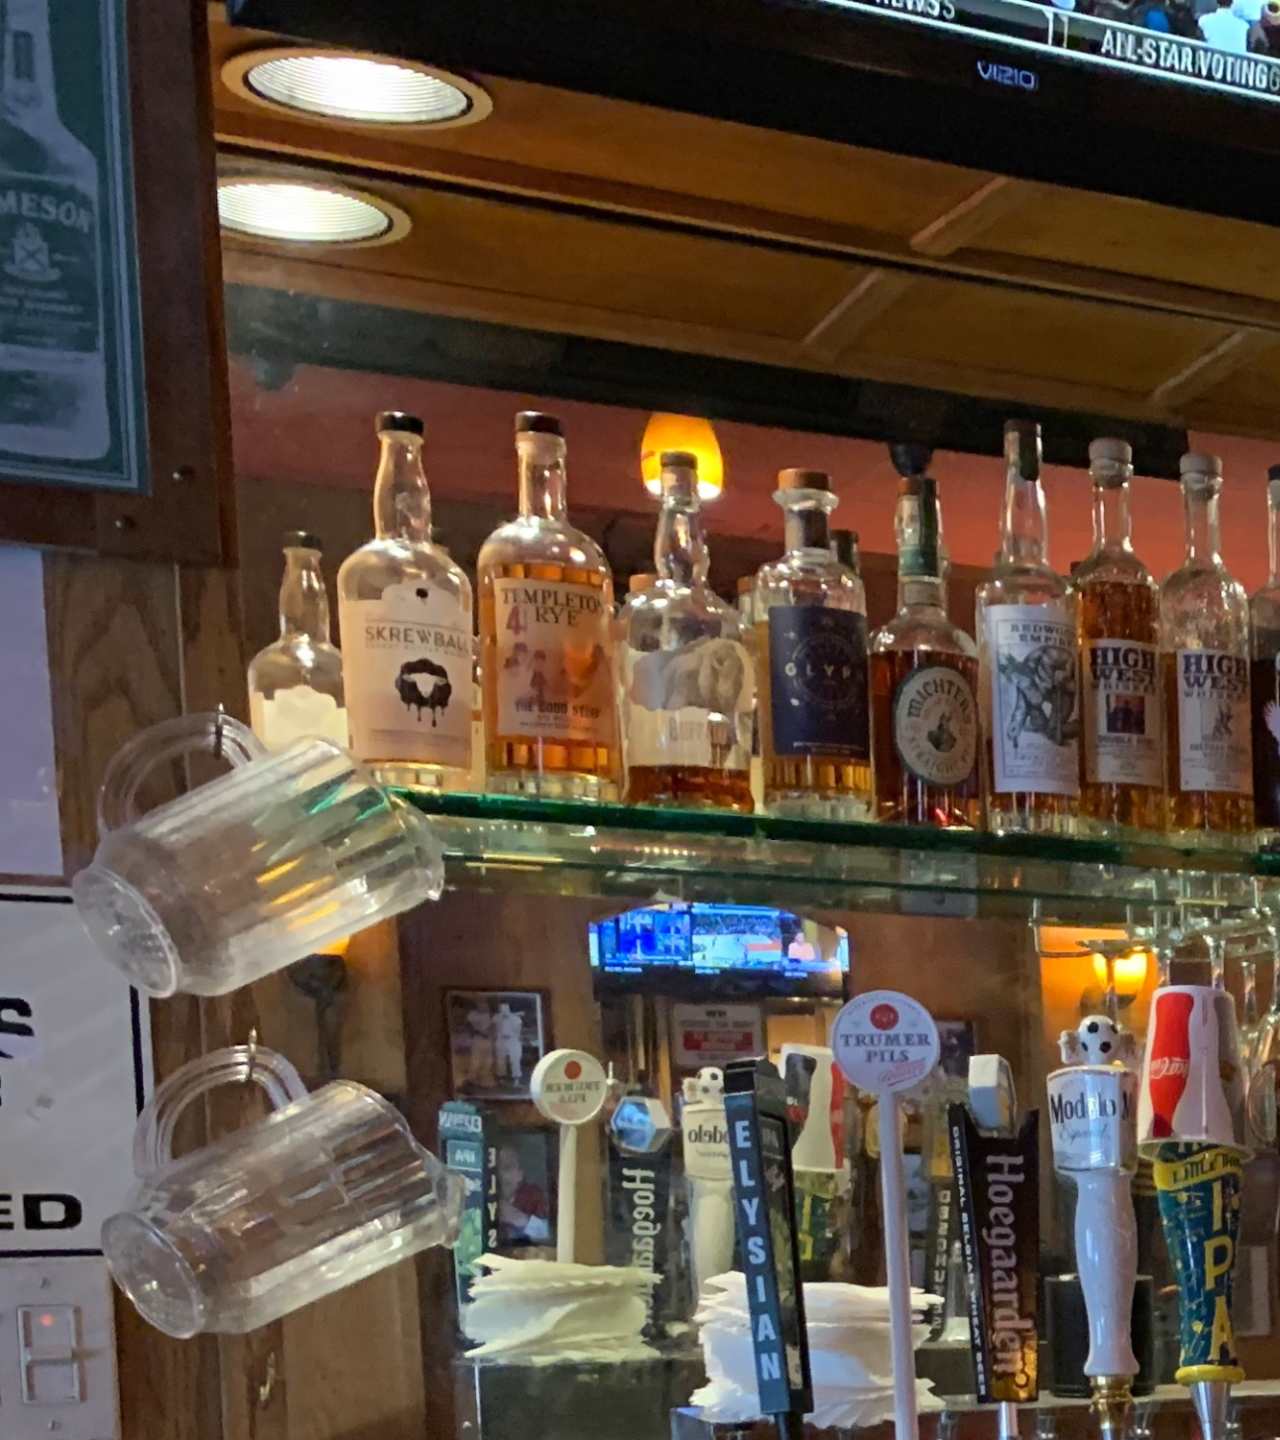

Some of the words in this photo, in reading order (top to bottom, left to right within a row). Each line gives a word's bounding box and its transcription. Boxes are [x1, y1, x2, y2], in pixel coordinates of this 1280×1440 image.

[977, 60, 1035, 89] VIZIO
[1101, 29, 1202, 74] ALL-STAR
[1199, 54, 1278, 92] VOTING
[535, 607, 579, 627] RYE
[840, 1033, 931, 1047] TRUMER
[865, 1049, 910, 1063] PILS
[1051, 1092, 1116, 1124] Modlo
[733, 1121, 781, 1379] ELYSIAN
[982, 1154, 1035, 1375] Hoegaarden
[1203, 1179, 1237, 1363] IPA
